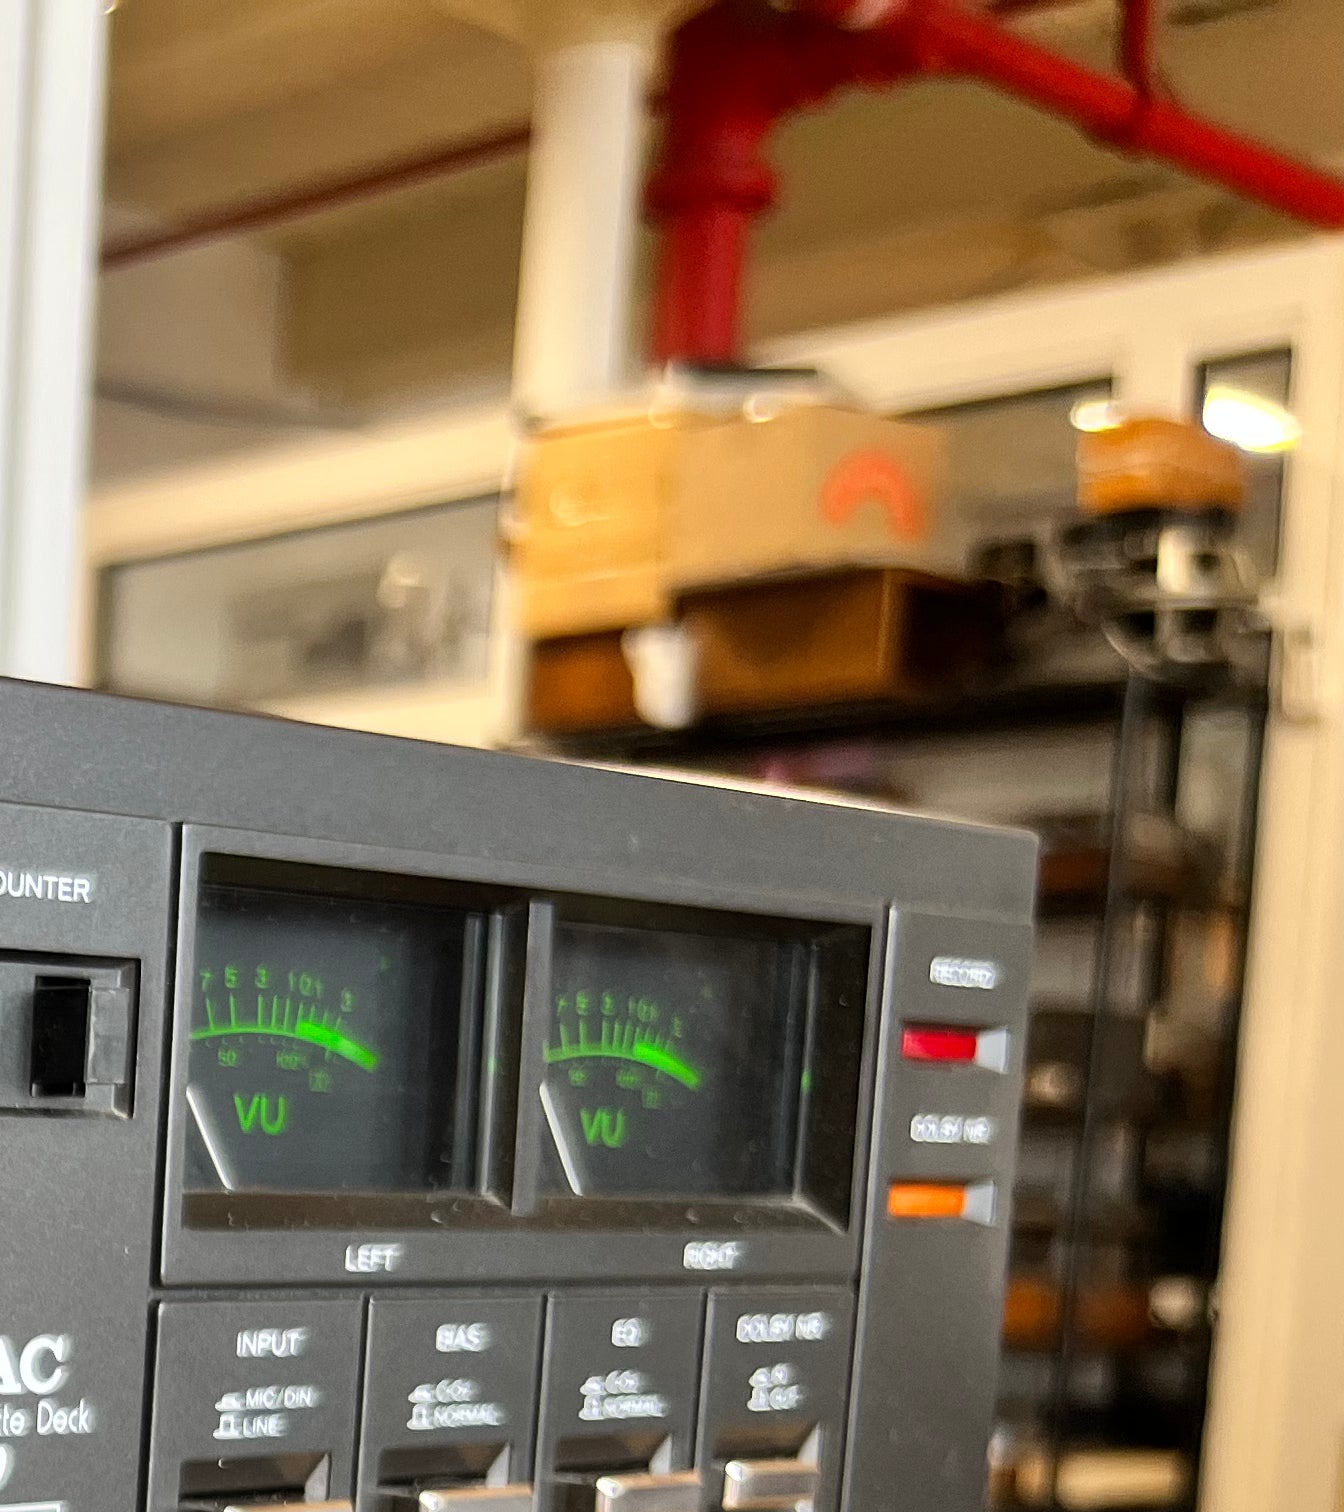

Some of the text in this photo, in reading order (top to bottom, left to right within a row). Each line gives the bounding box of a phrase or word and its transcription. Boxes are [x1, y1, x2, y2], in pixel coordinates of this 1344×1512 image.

[232, 1093, 288, 1136] VU
[579, 1106, 628, 1149] VU
[344, 1243, 405, 1273] LEFT
[236, 1326, 311, 1359] INPUT
[435, 1321, 491, 1352] BIAS
[245, 1384, 320, 1409] MIC/DIN
[36, 1397, 96, 1435] Deck
[242, 1412, 289, 1439] LINE
